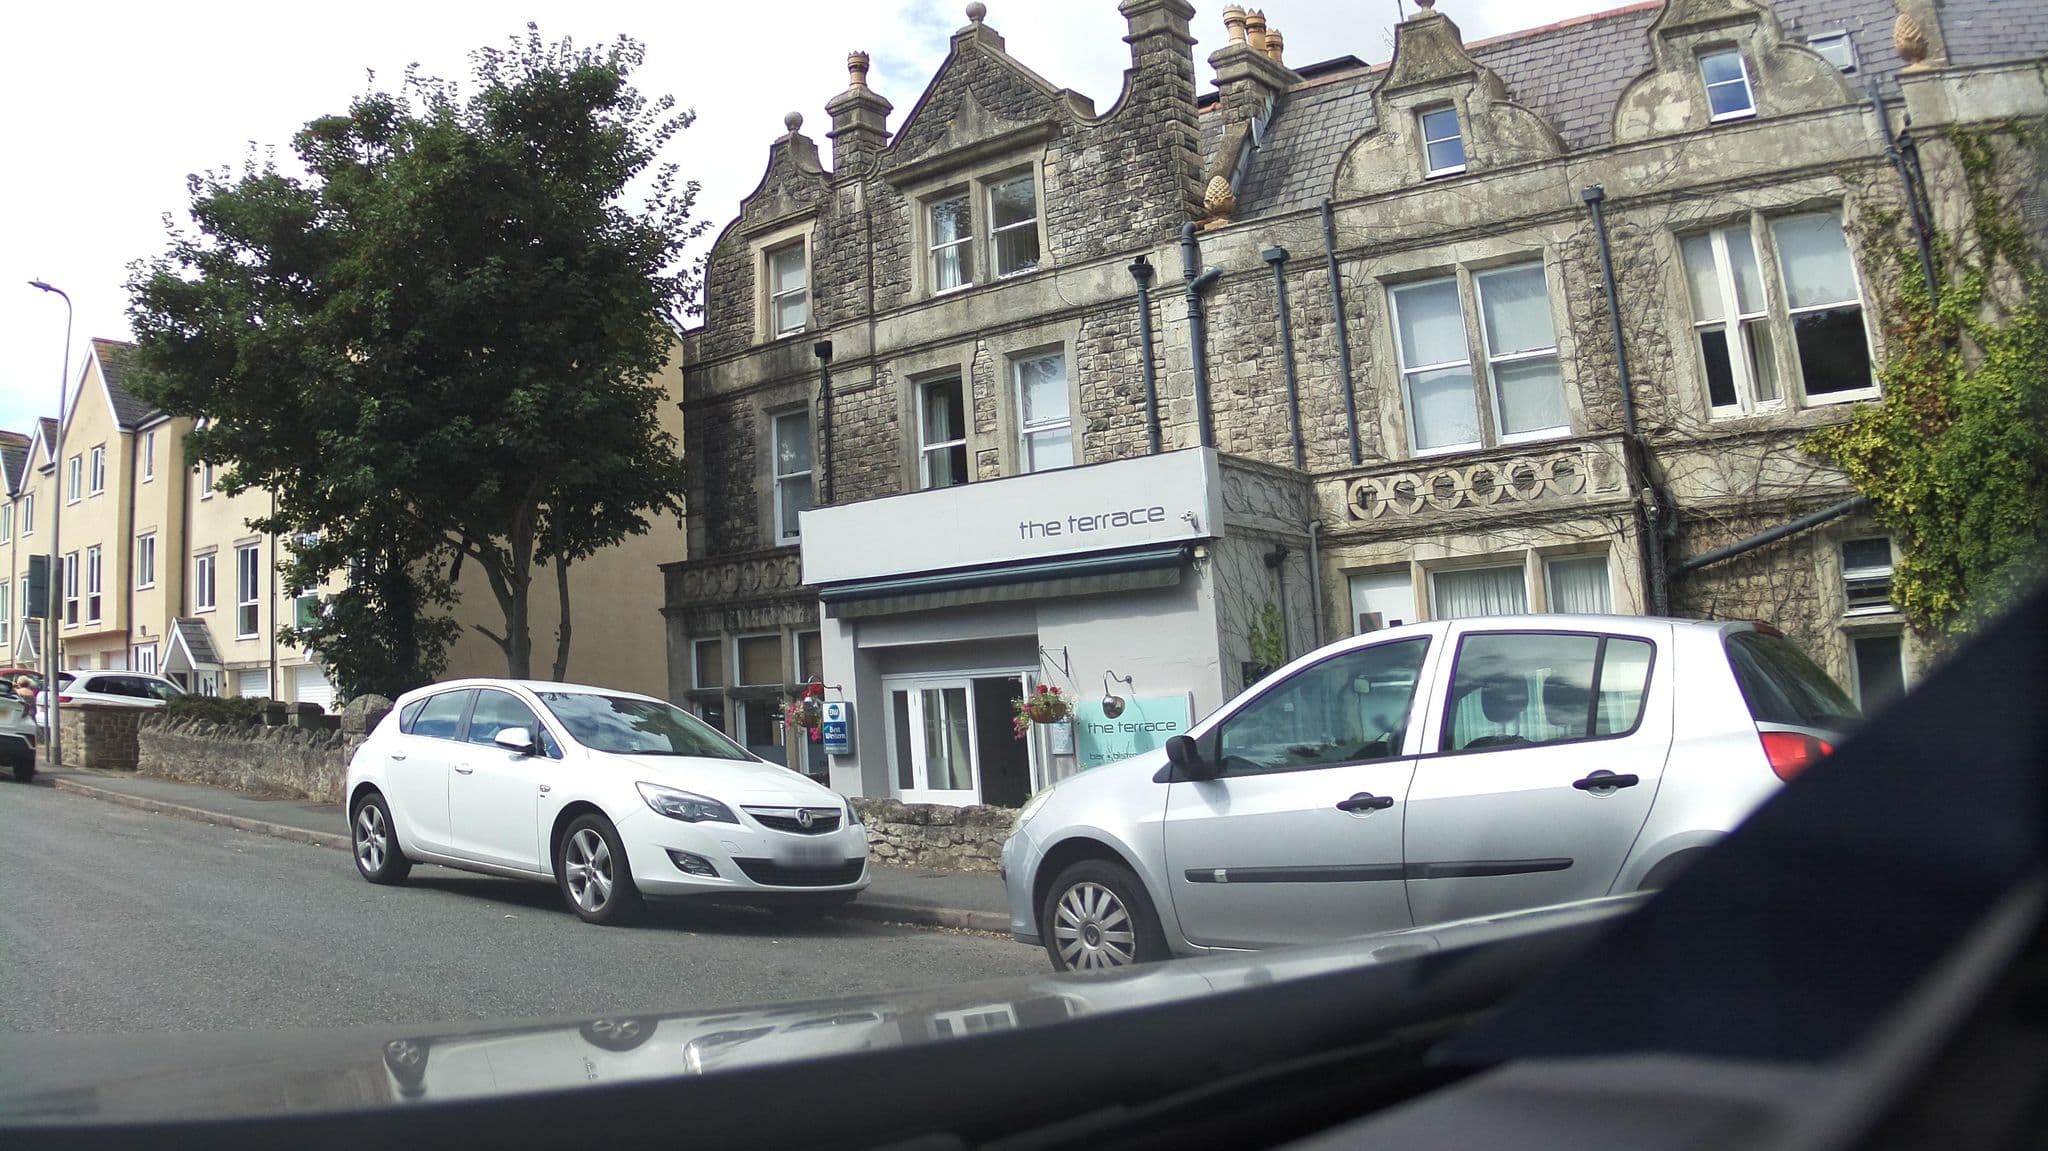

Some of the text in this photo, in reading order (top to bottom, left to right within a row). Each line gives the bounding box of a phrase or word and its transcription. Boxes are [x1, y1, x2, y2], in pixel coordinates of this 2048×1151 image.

[1019, 506, 1165, 539] the terrace
[1088, 720, 1177, 734] the terrace
[1089, 752, 1105, 760] bar
